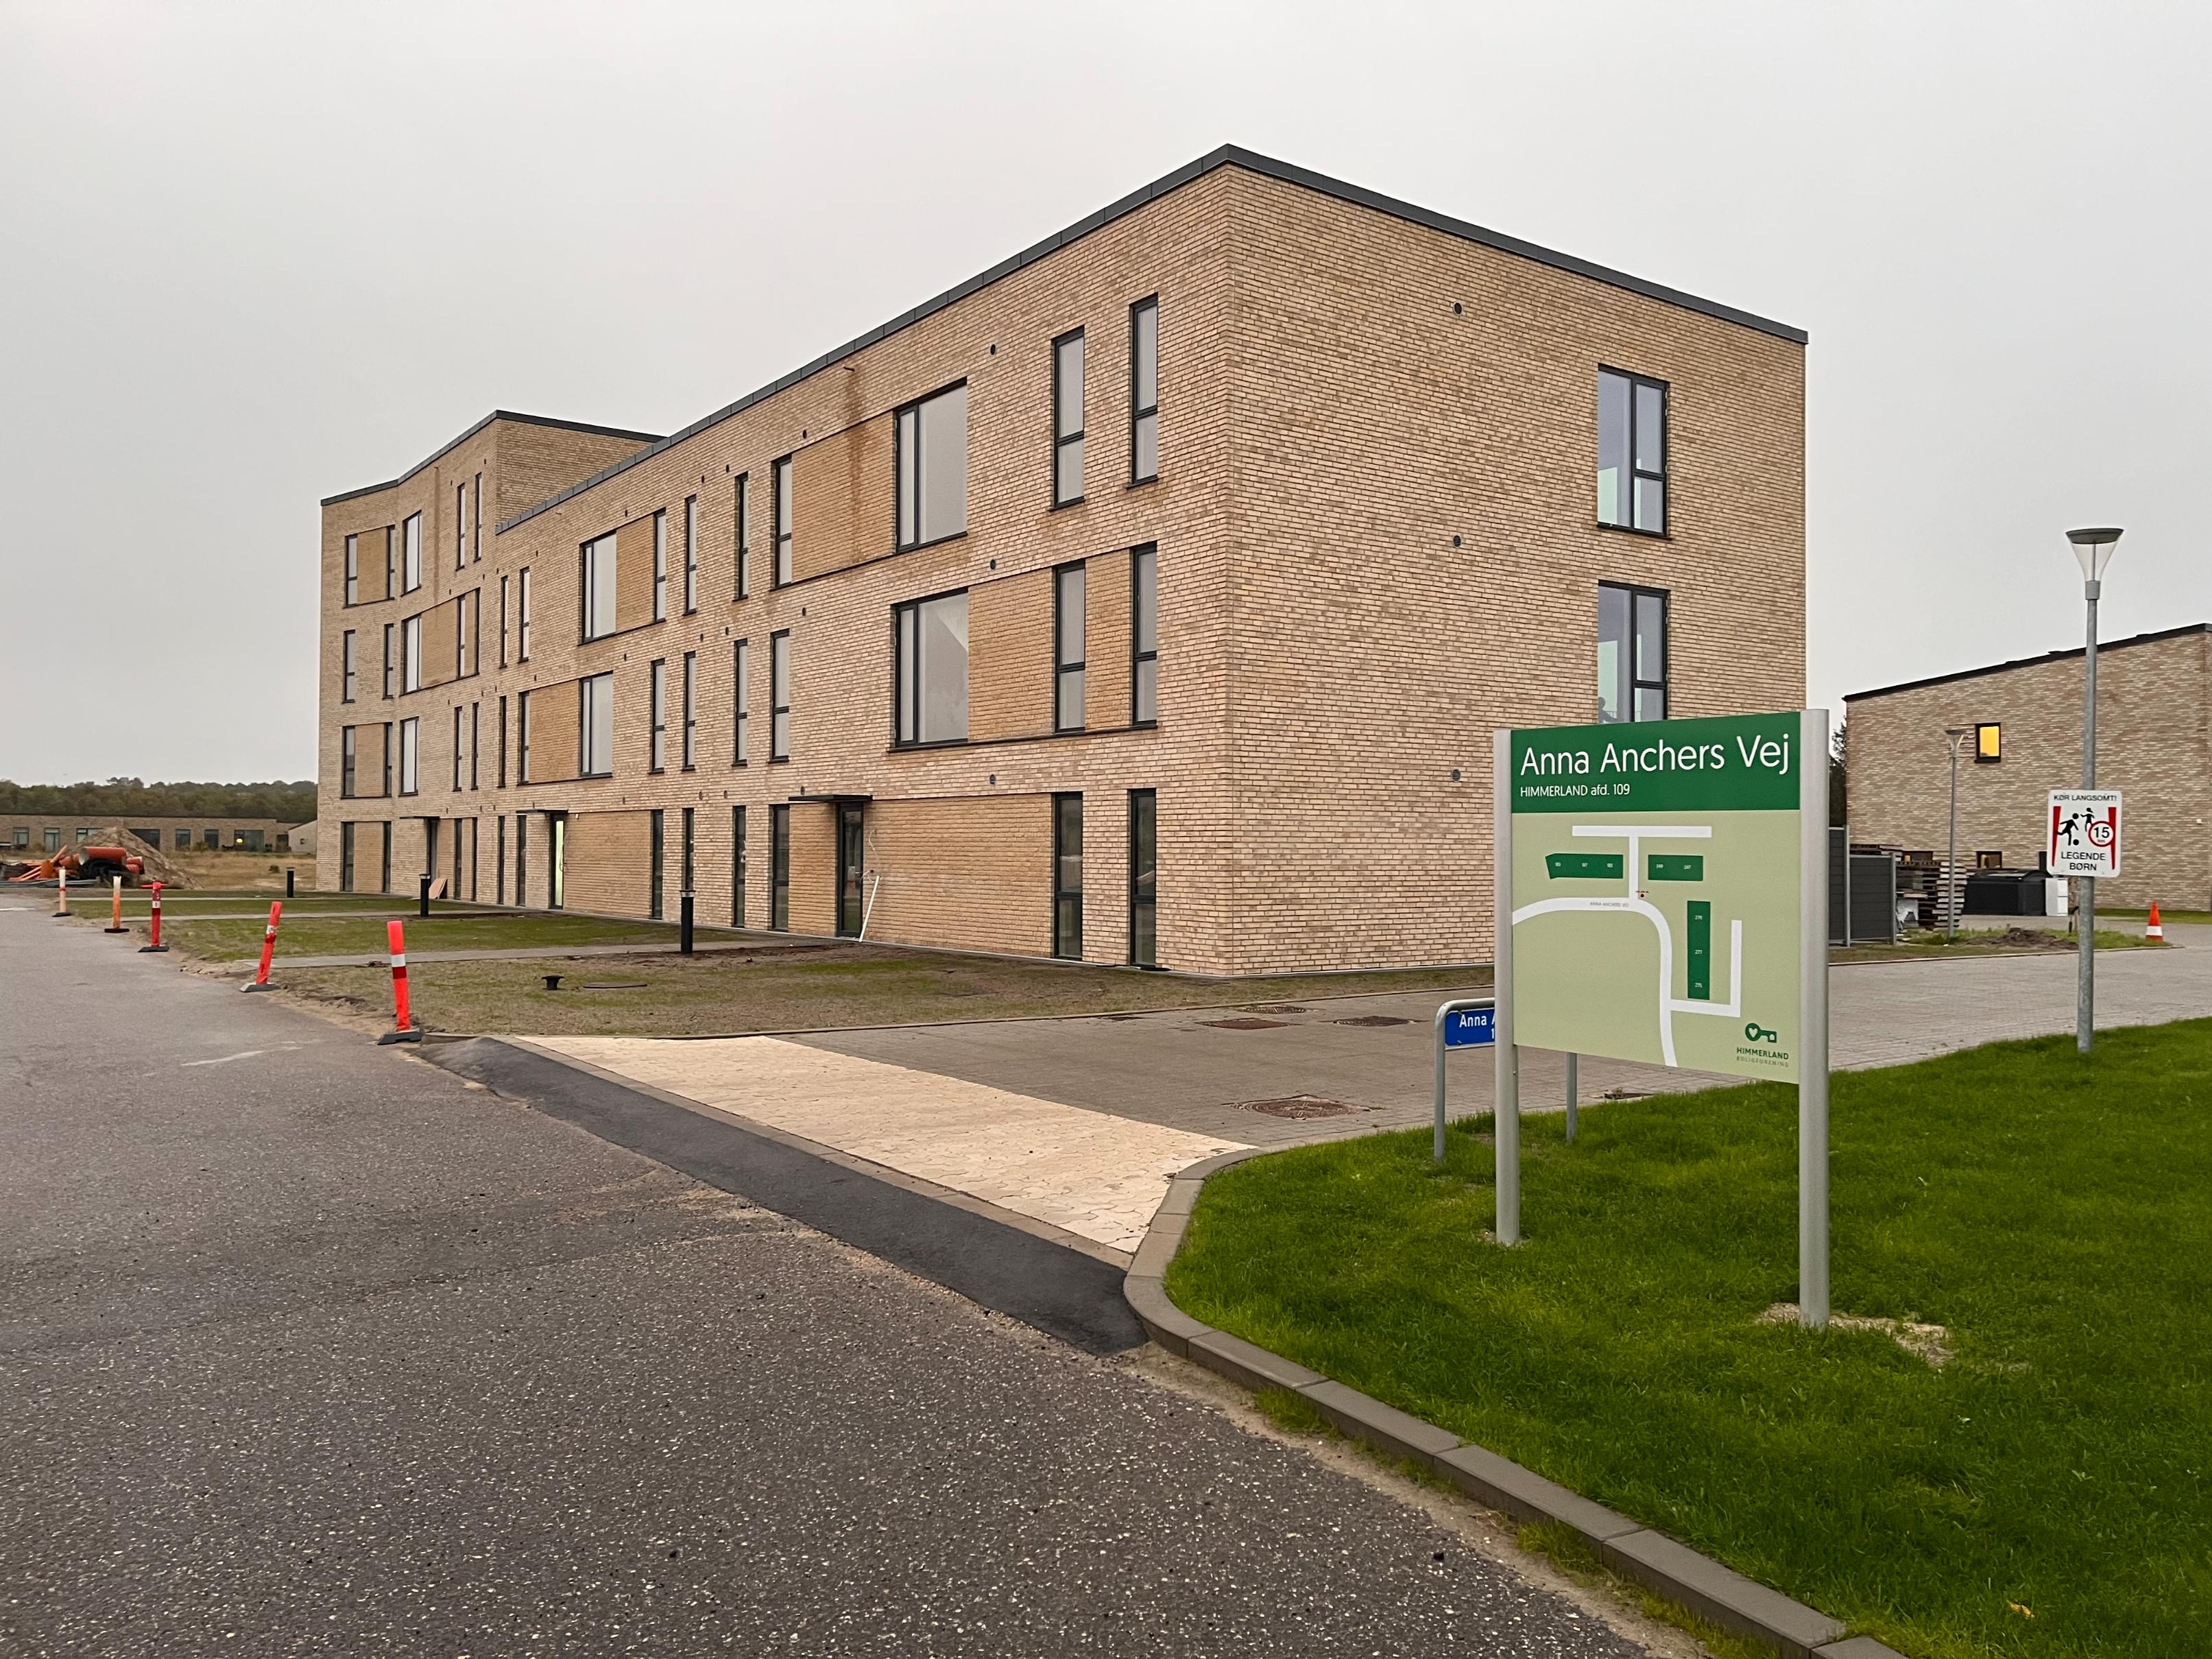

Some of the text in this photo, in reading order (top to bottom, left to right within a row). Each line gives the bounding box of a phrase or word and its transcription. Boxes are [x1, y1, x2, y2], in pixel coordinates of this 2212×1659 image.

[1520, 733, 1789, 776] Anna Anchers Vej
[1520, 783, 1631, 797] HIMMERLAND afd. 109
[2093, 826, 2110, 838] 15
[2060, 851, 2106, 861] LEGENDE
[2069, 862, 2097, 871] BØRN
[1459, 1014, 1487, 1028] Anna
[1736, 1047, 1789, 1060] HIMMERLAND
